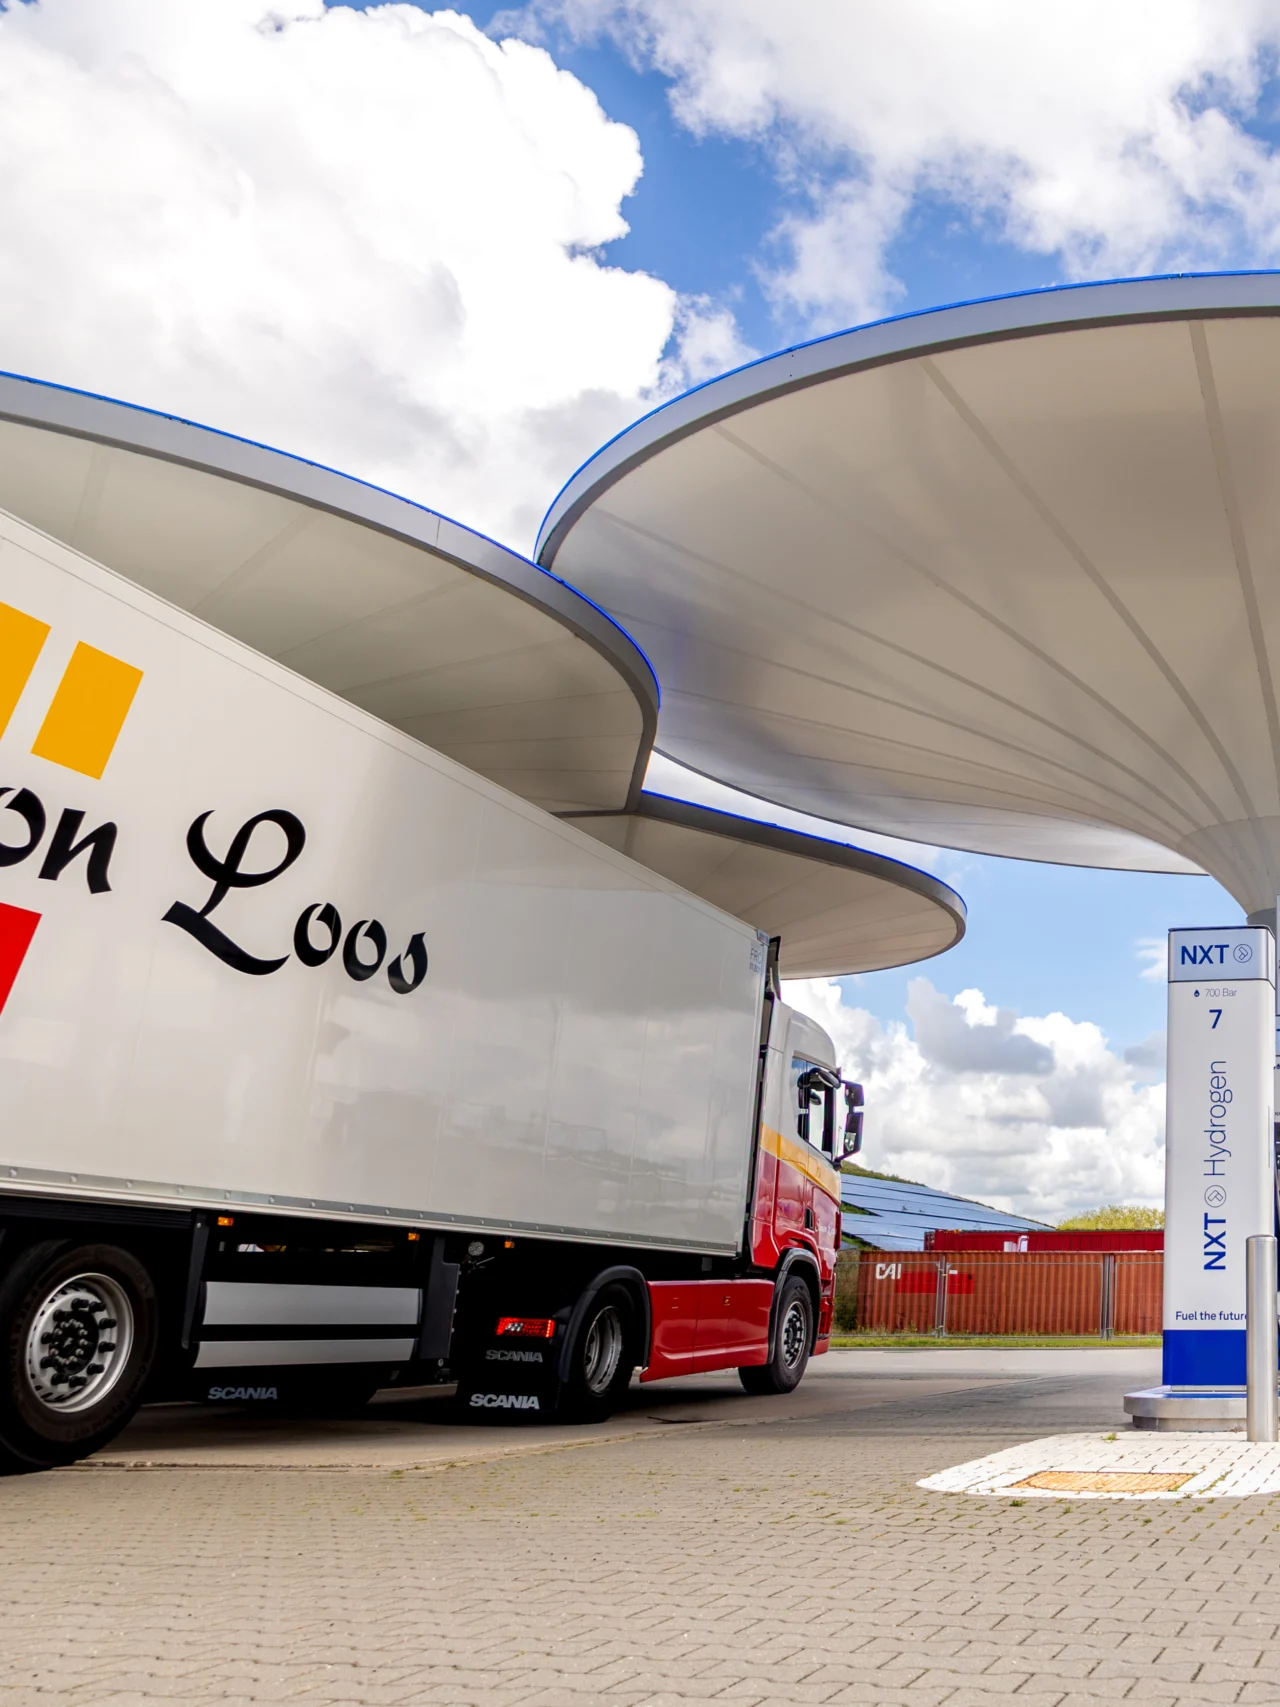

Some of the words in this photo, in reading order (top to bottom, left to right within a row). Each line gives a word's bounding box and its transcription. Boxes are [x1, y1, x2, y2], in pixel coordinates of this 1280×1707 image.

[161, 809, 428, 995] Loos
[1181, 944, 1230, 965] NXT
[1205, 988, 1221, 997] 700
[1222, 988, 1237, 997] Bar
[1209, 1009, 1223, 1029] 7
[1203, 1060, 1233, 1176] Hydrogen
[1203, 1212, 1226, 1270] NXT
[876, 1263, 902, 1280] CAI
[1175, 1311, 1197, 1320] Fuel
[1200, 1311, 1216, 1320] the
[486, 1349, 543, 1363] SCANIA
[208, 1387, 278, 1400] SCANIA
[469, 1393, 540, 1410] SCANIA
